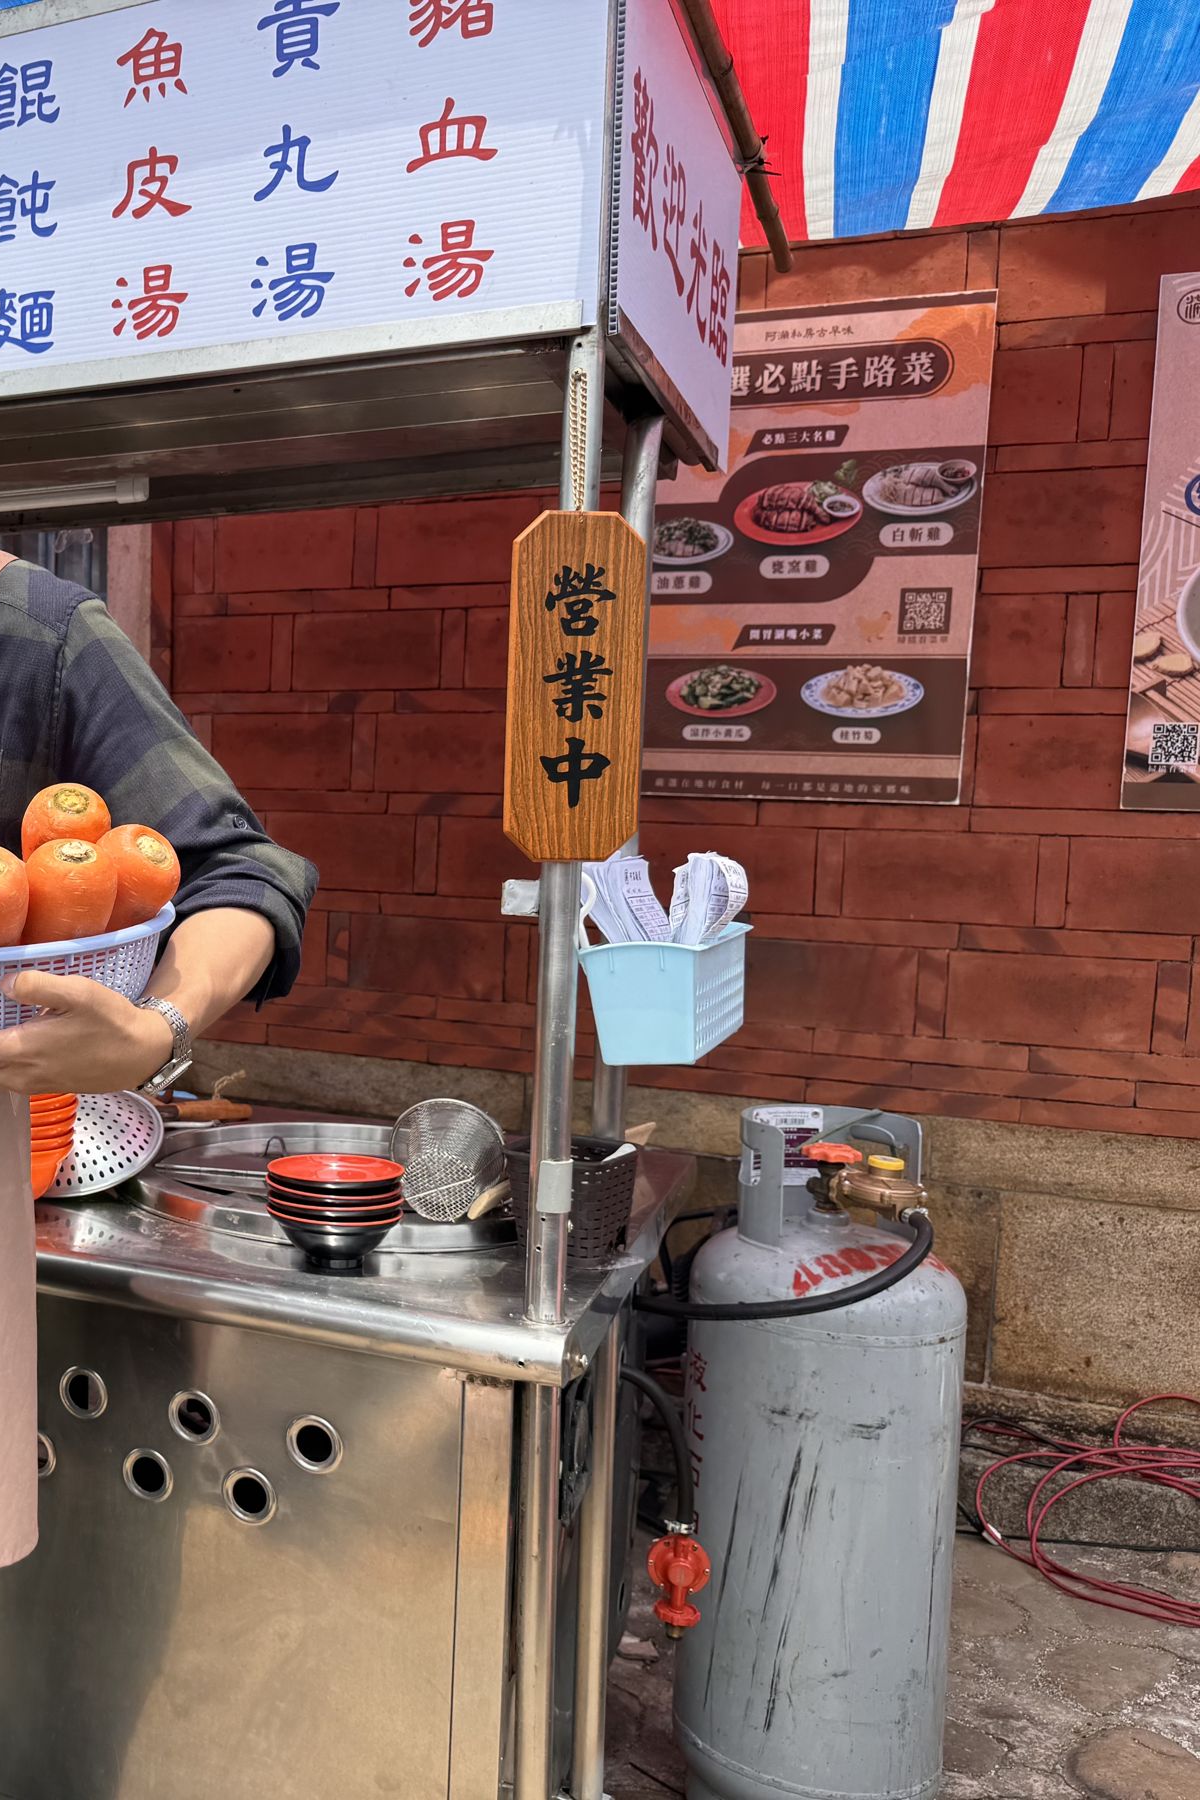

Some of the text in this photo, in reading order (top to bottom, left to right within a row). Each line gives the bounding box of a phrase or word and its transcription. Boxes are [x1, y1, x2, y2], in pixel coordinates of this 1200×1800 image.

[111, 27, 192, 340] 魚皮湯
[251, 0, 340, 321] 貢丸湯
[405, 0, 498, 302] 豬血湯
[631, 66, 730, 368] 歡迎光臨
[540, 563, 616, 809] 營業中
[891, 526, 941, 544] 白斬雞
